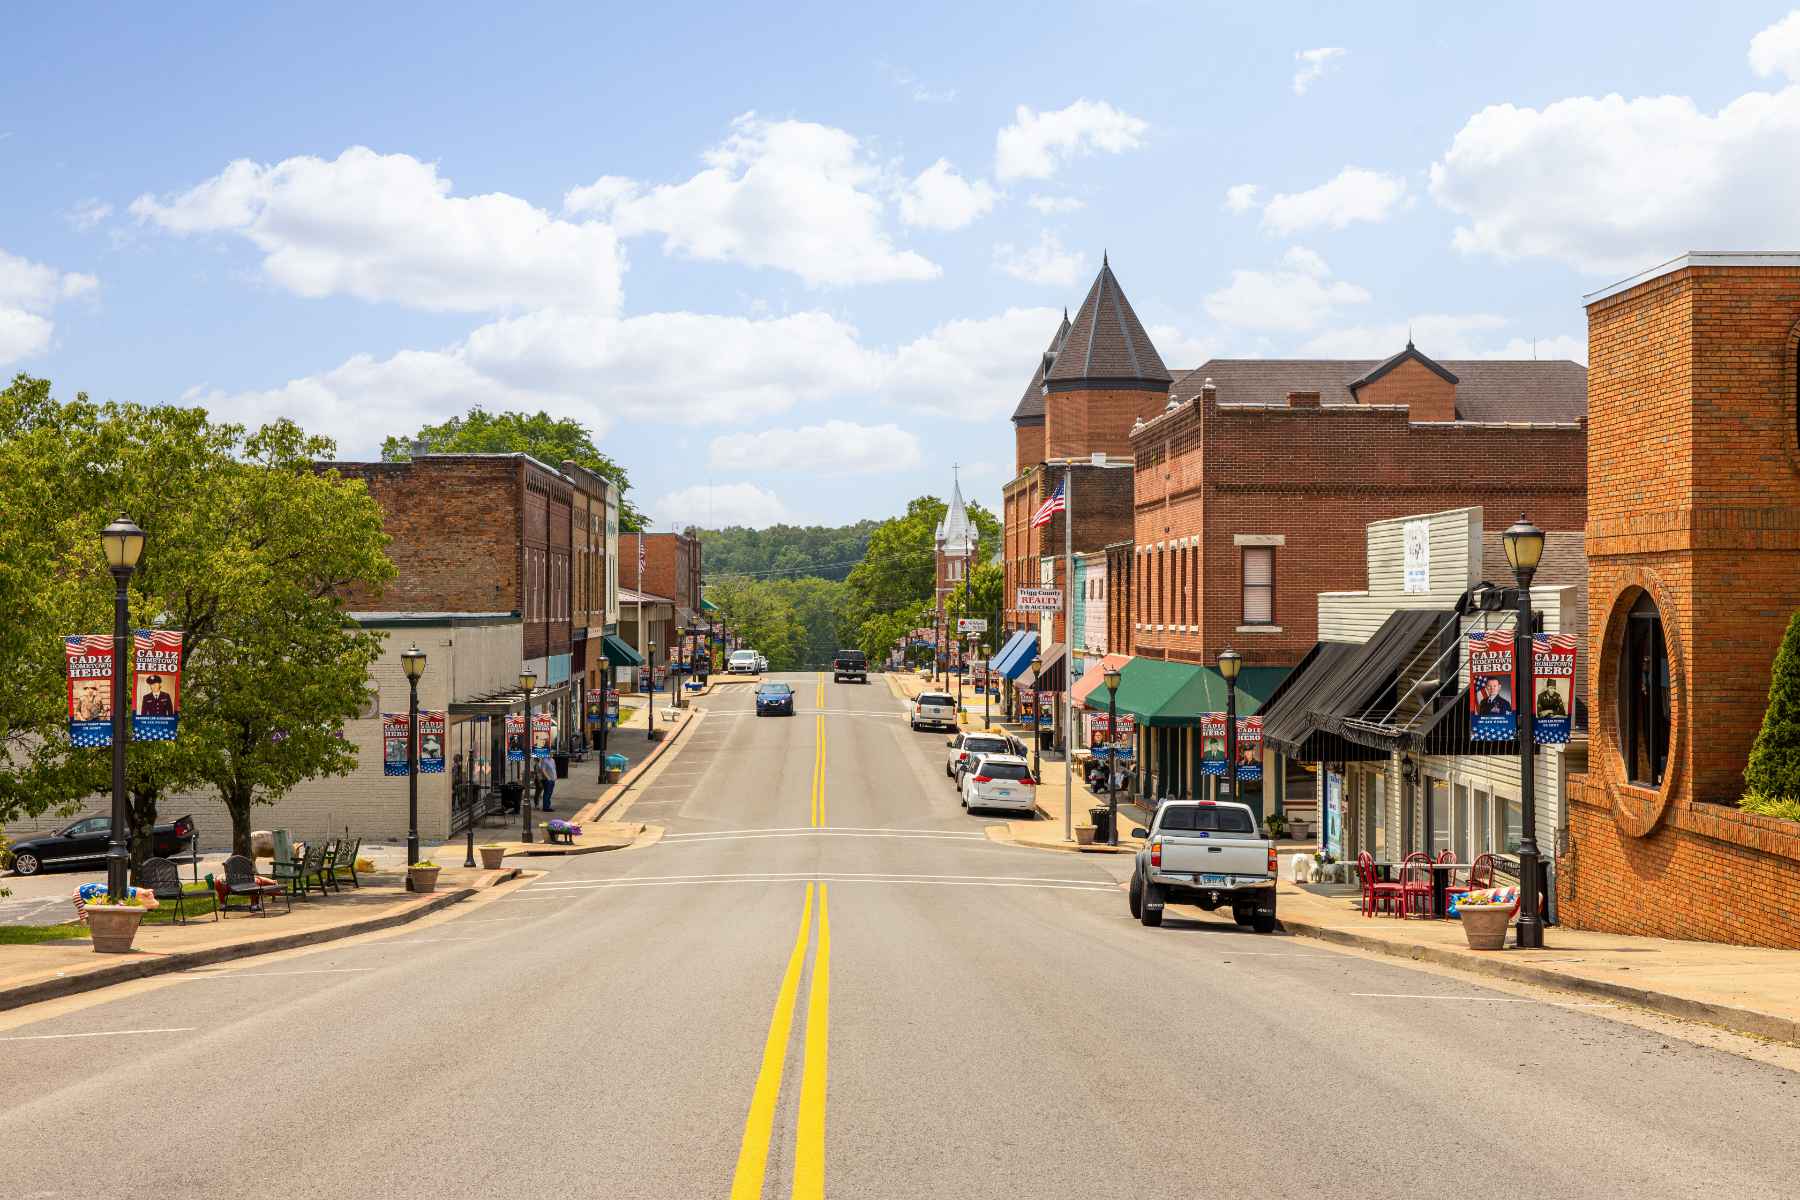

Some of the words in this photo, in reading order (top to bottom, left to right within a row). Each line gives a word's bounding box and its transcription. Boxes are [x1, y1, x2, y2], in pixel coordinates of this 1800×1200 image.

[1021, 596, 1059, 604] REALTY
[136, 649, 179, 659] CADIZ
[1471, 650, 1512, 660] CADIZ
[1534, 653, 1574, 662] CADIZ
[69, 655, 112, 664] CADIZ
[136, 657, 178, 665] HOMETOWN
[135, 662, 178, 673] HERO
[1471, 664, 1512, 673] HERO
[1534, 666, 1573, 675] HERO
[70, 668, 112, 678] HERO
